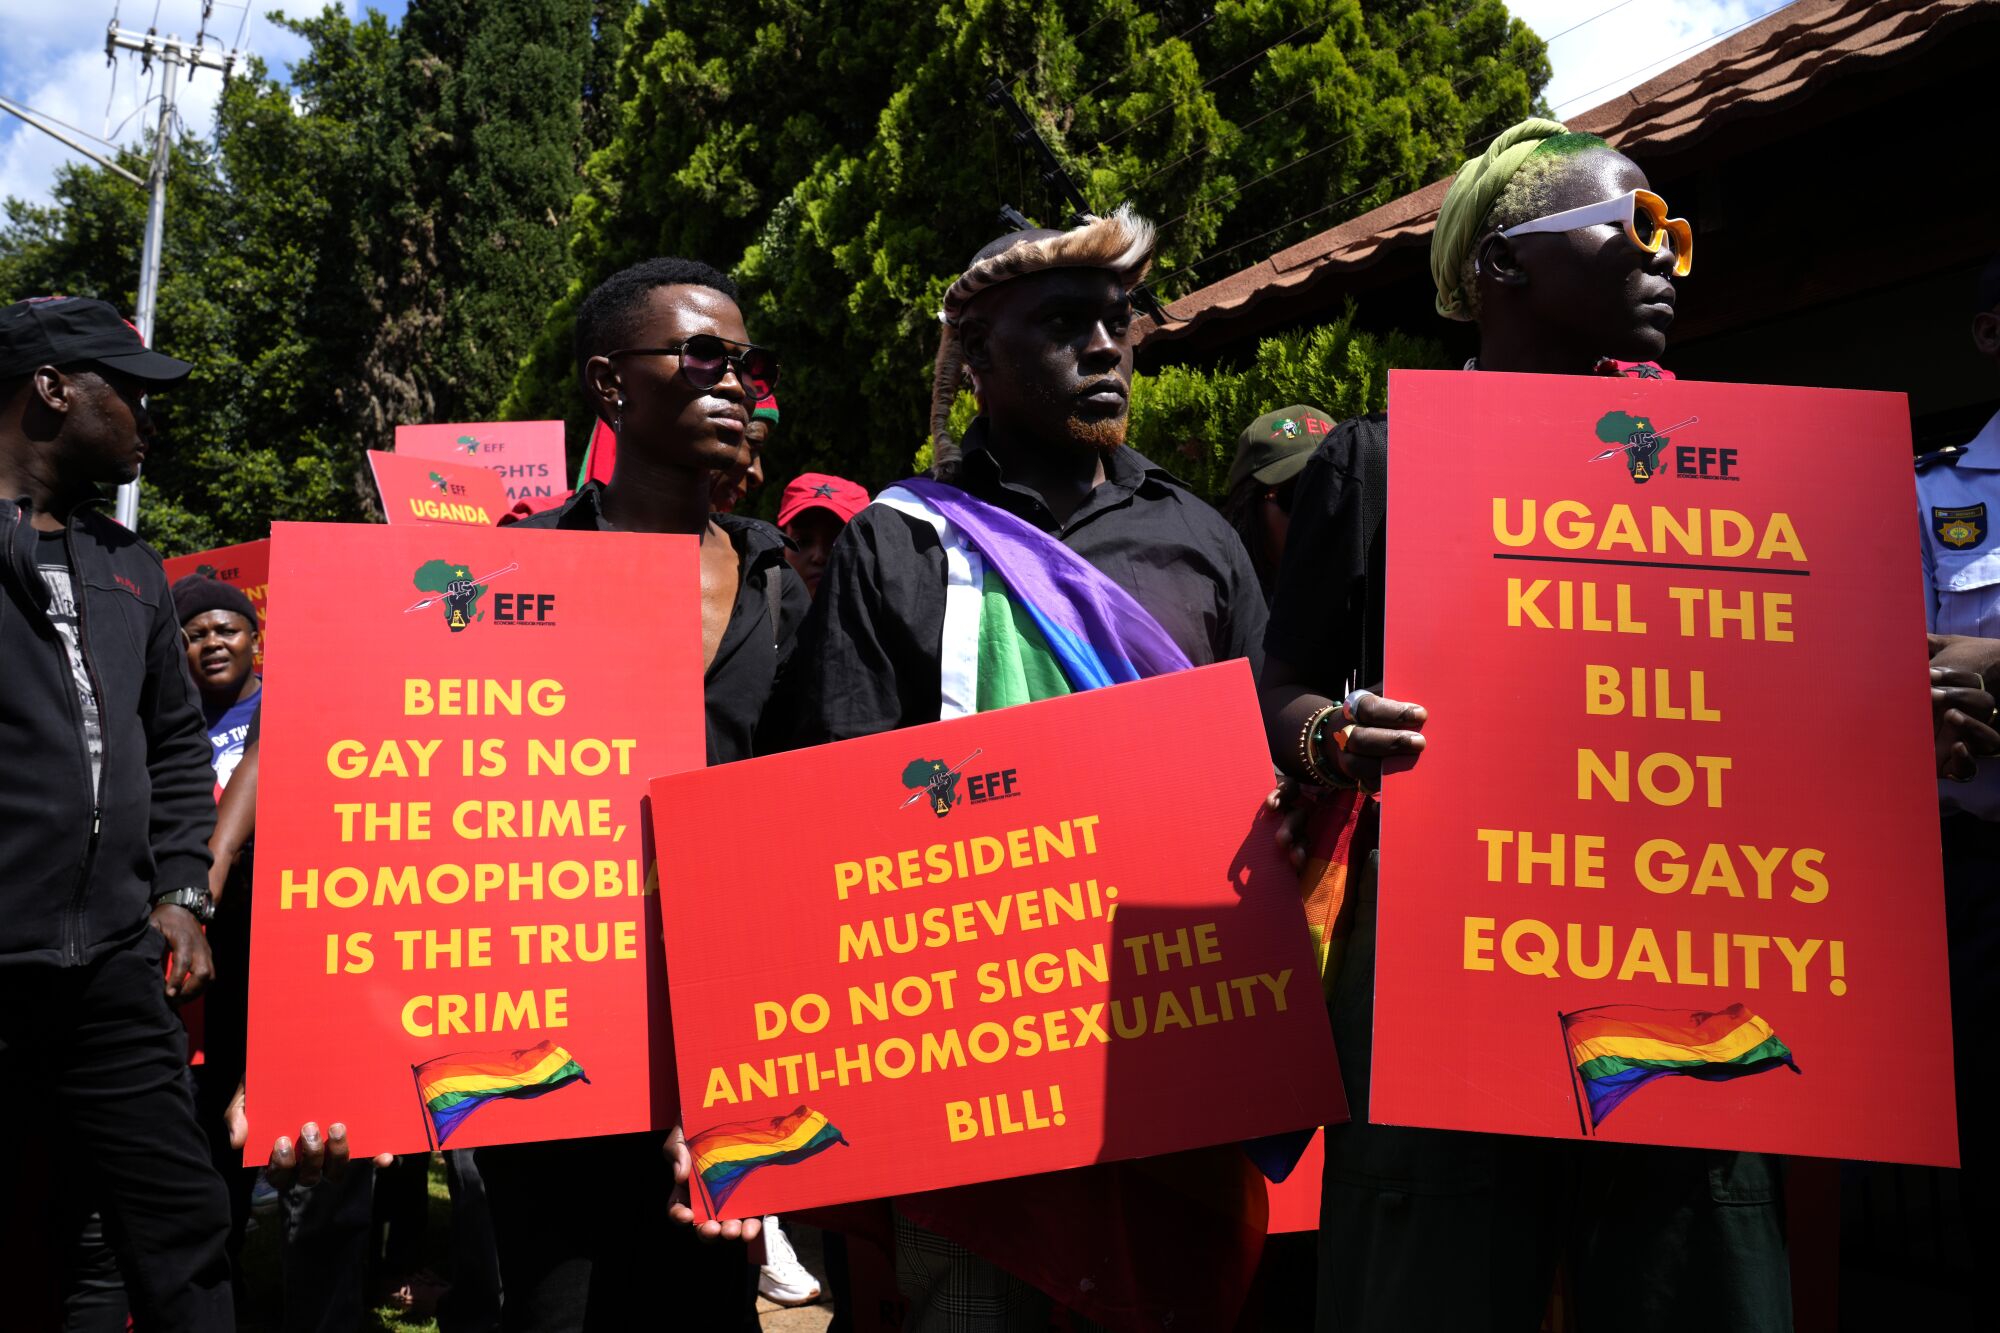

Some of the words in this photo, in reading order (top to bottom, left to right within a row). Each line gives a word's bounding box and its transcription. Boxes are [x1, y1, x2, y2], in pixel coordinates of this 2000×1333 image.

[483, 443, 505, 453] EFF
[1306, 418, 1334, 435] EF
[484, 463, 548, 478] GHTS
[1676, 446, 1738, 475] EFF
[410, 498, 491, 525] UGANDA
[450, 484, 466, 497] EFF
[1494, 498, 1806, 560] UGANDA
[494, 593, 555, 621] EFF
[1508, 578, 1646, 633] KILL
[1670, 588, 1793, 641] THE
[405, 679, 565, 716] BEING
[1587, 665, 1720, 720] BILL
[211, 733, 229, 748] OF
[228, 724, 250, 742] TH
[327, 740, 442, 778] GAY
[463, 740, 506, 776] IS
[528, 739, 636, 777] NOT
[967, 769, 1017, 801] EFF
[1579, 749, 1731, 807] NOT
[334, 804, 430, 841] THE
[453, 800, 625, 841] CRIME,
[835, 816, 1098, 900] PRESIDENT
[1478, 829, 1605, 888] THE
[1636, 840, 1828, 903] GAYS
[840, 880, 1119, 962] MUSEVENI;
[327, 935, 373, 974] IS
[395, 928, 491, 970] THE
[511, 922, 636, 966] TRUE
[1464, 917, 1846, 997] EQUALITY!
[755, 994, 829, 1040] DO
[849, 970, 956, 1024] NOT
[977, 943, 1108, 1002] SIGN
[1125, 925, 1221, 976] THE
[402, 989, 567, 1037] CRIME
[704, 971, 1290, 1107] ANTI-HOMOSEXUALITY
[946, 1086, 1066, 1141] BILL!
